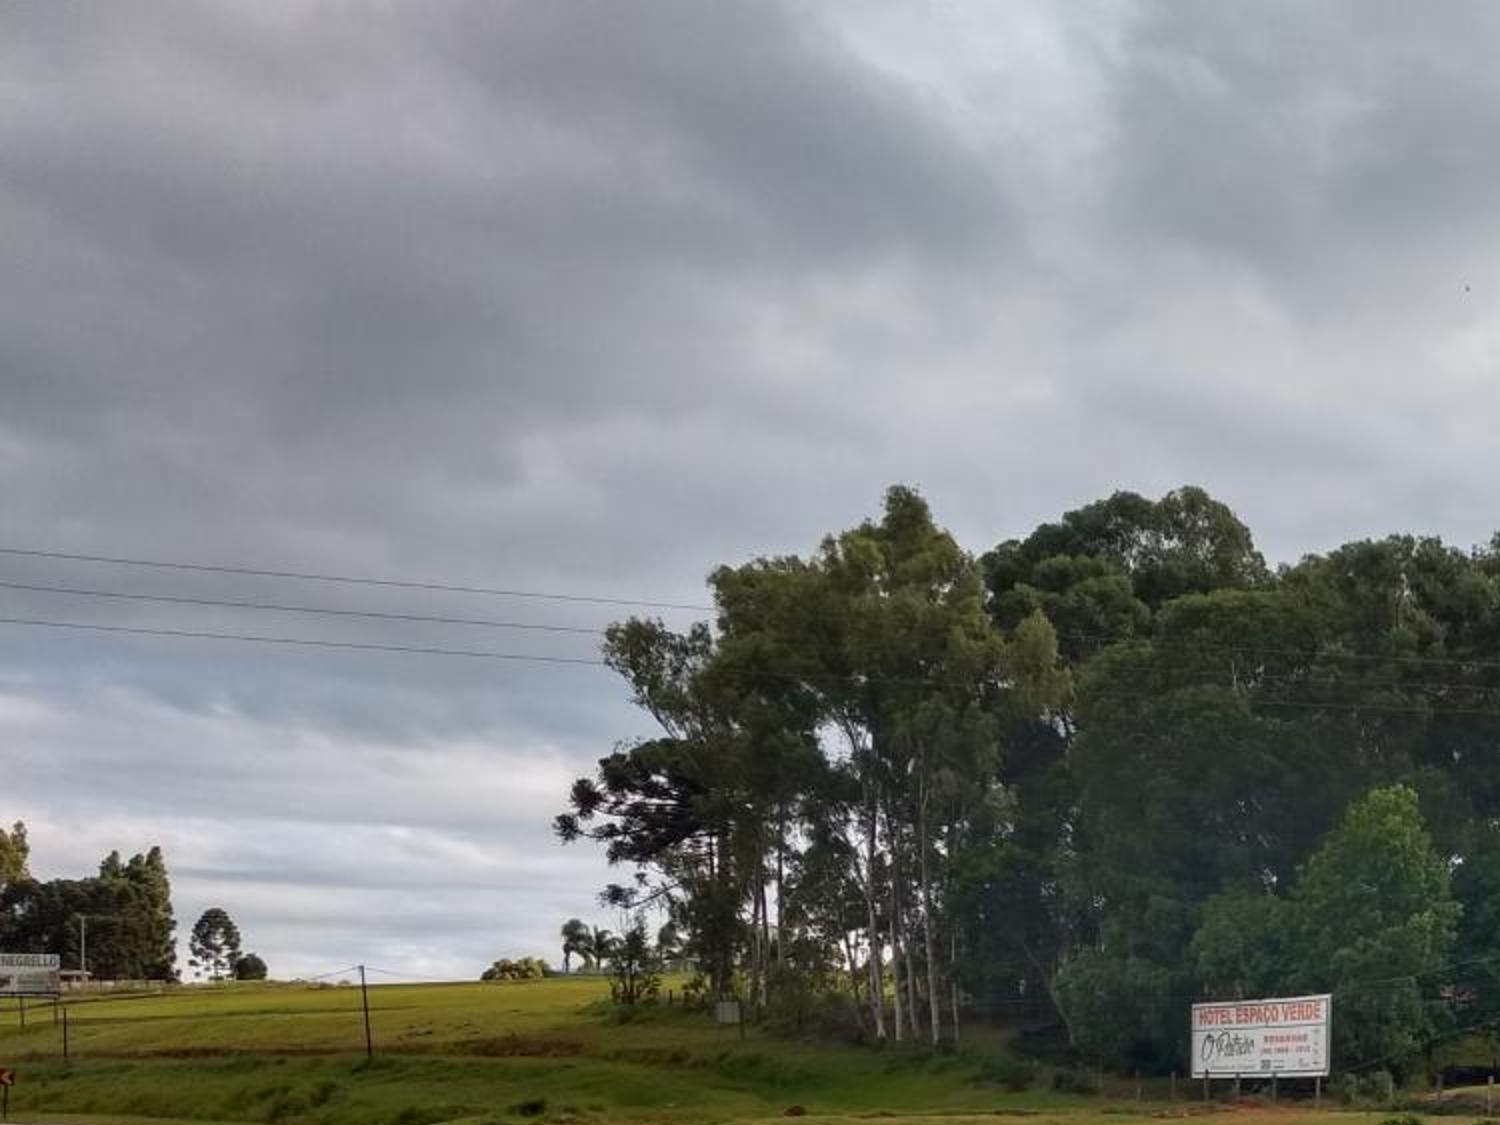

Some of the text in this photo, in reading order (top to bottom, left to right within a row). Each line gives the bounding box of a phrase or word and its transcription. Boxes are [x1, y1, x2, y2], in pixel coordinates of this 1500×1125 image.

[1199, 1000, 1321, 1025] HOTEL ESPAÇO VERDE
